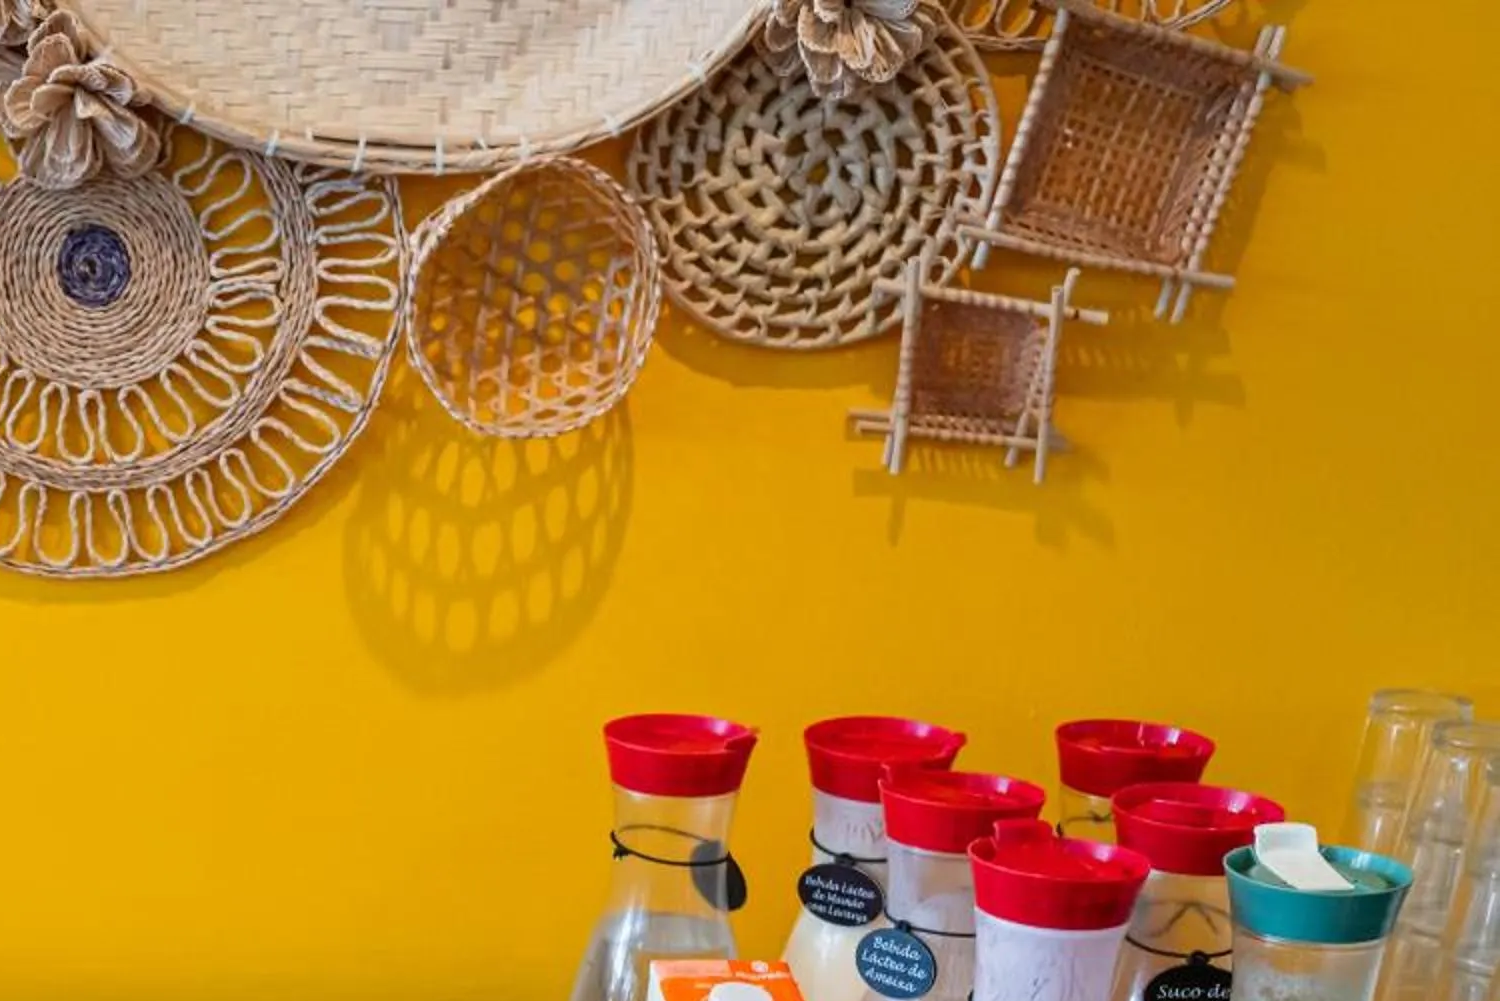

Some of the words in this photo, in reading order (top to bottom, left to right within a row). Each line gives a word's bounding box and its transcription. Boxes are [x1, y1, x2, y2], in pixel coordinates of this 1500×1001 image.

[873, 936, 921, 961] Bebida
[861, 948, 908, 973] Láctea
[907, 963, 927, 980] de
[865, 967, 917, 993] Ameixa
[1156, 983, 1205, 999] Suco
